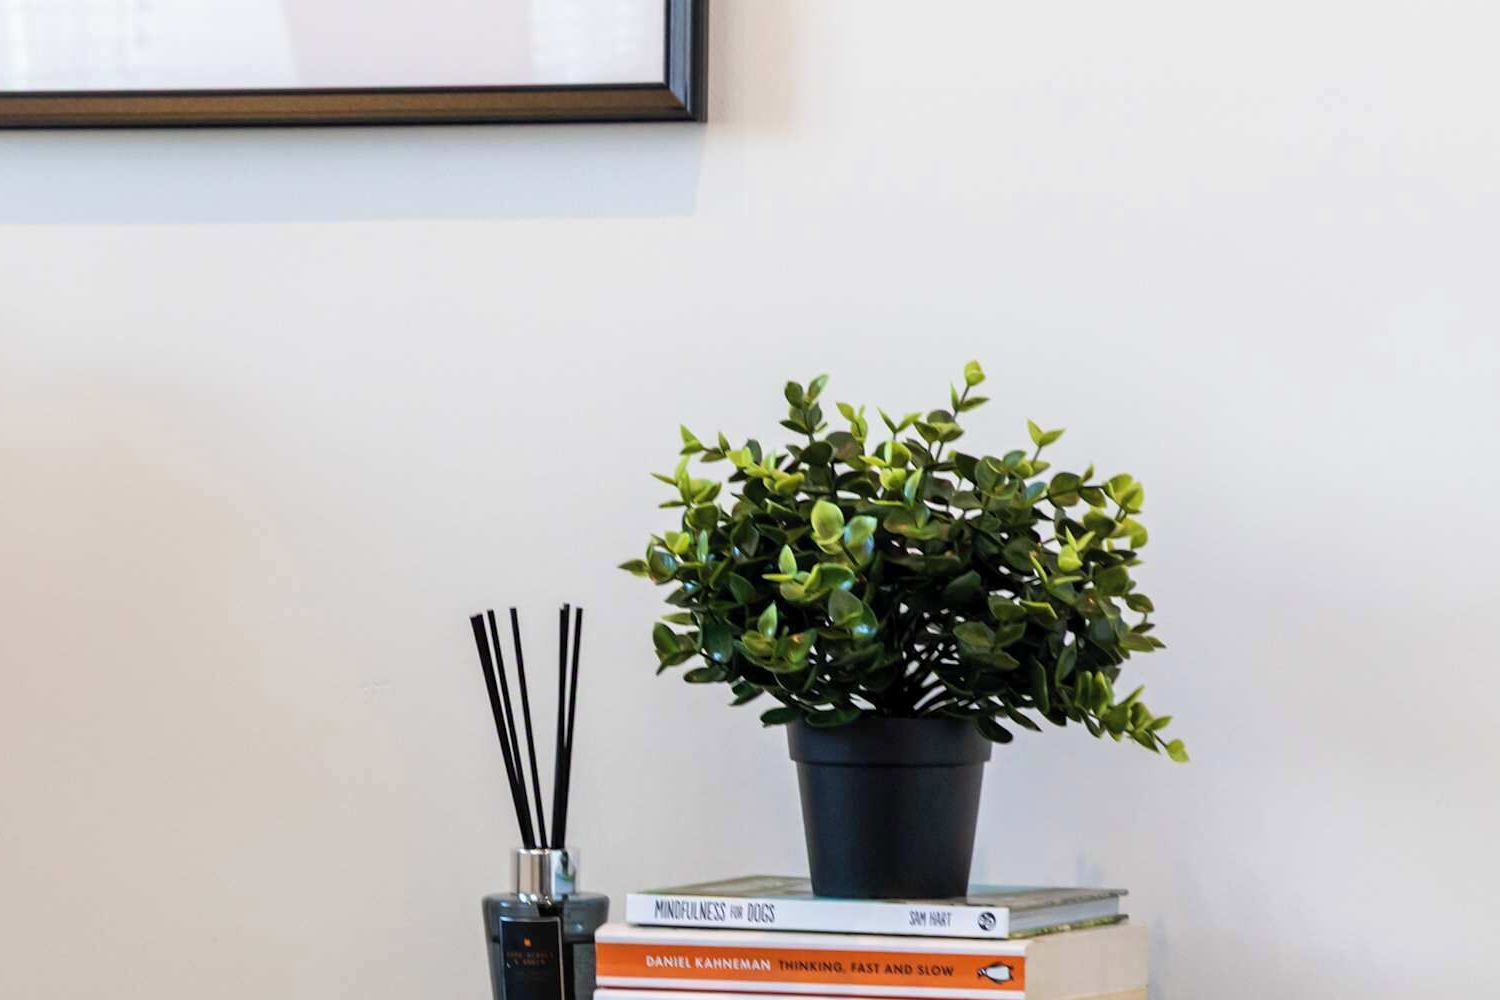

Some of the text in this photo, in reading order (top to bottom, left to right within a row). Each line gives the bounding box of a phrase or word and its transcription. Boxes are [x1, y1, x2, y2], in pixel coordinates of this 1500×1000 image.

[654, 898, 776, 923] MINDFULNESS FOR DOGS
[909, 909, 953, 927] SAM HART
[645, 954, 955, 977] DANIEL KAHNEMAN THINKING, FAST AND SLOW
